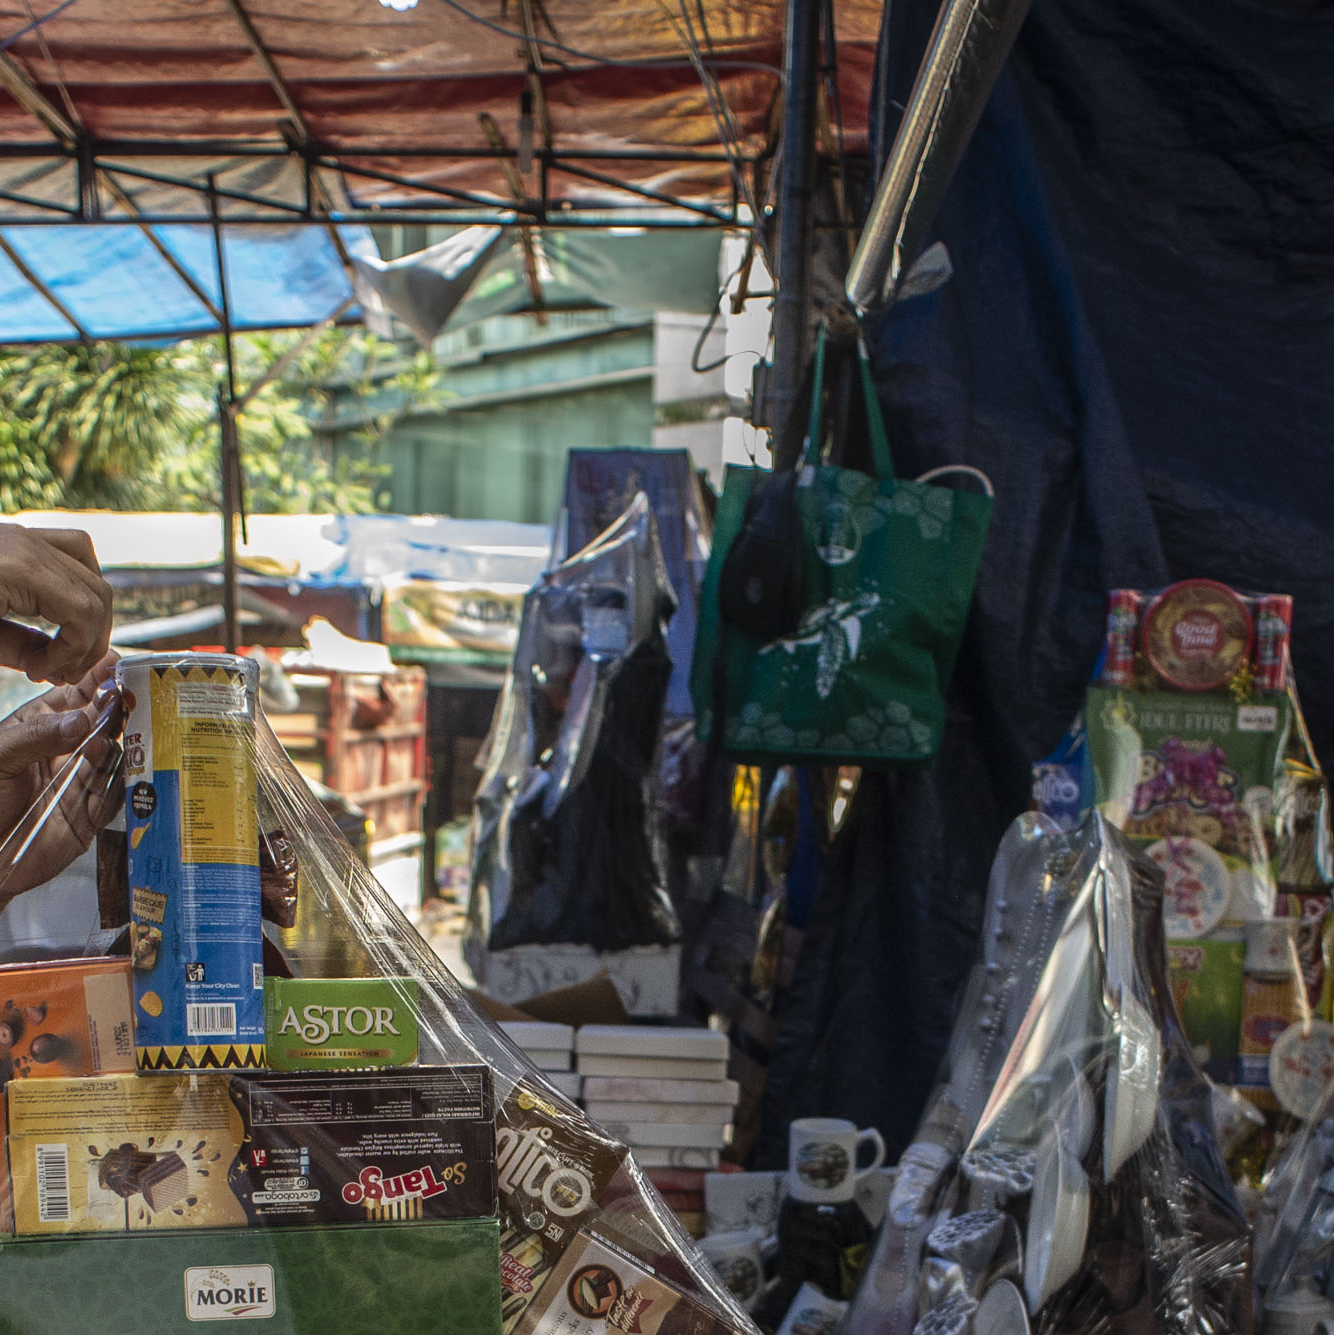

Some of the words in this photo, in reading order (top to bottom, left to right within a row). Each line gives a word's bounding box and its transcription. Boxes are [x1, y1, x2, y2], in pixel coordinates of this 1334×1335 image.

[277, 1005, 401, 1044] ASTOR
[342, 1165, 447, 1205] Tango
[441, 1162, 467, 1185] So
[497, 1251, 534, 1282] Real
[196, 1279, 268, 1309] MORIE
[599, 1292, 633, 1332] Taste
[615, 1289, 651, 1334] difference
